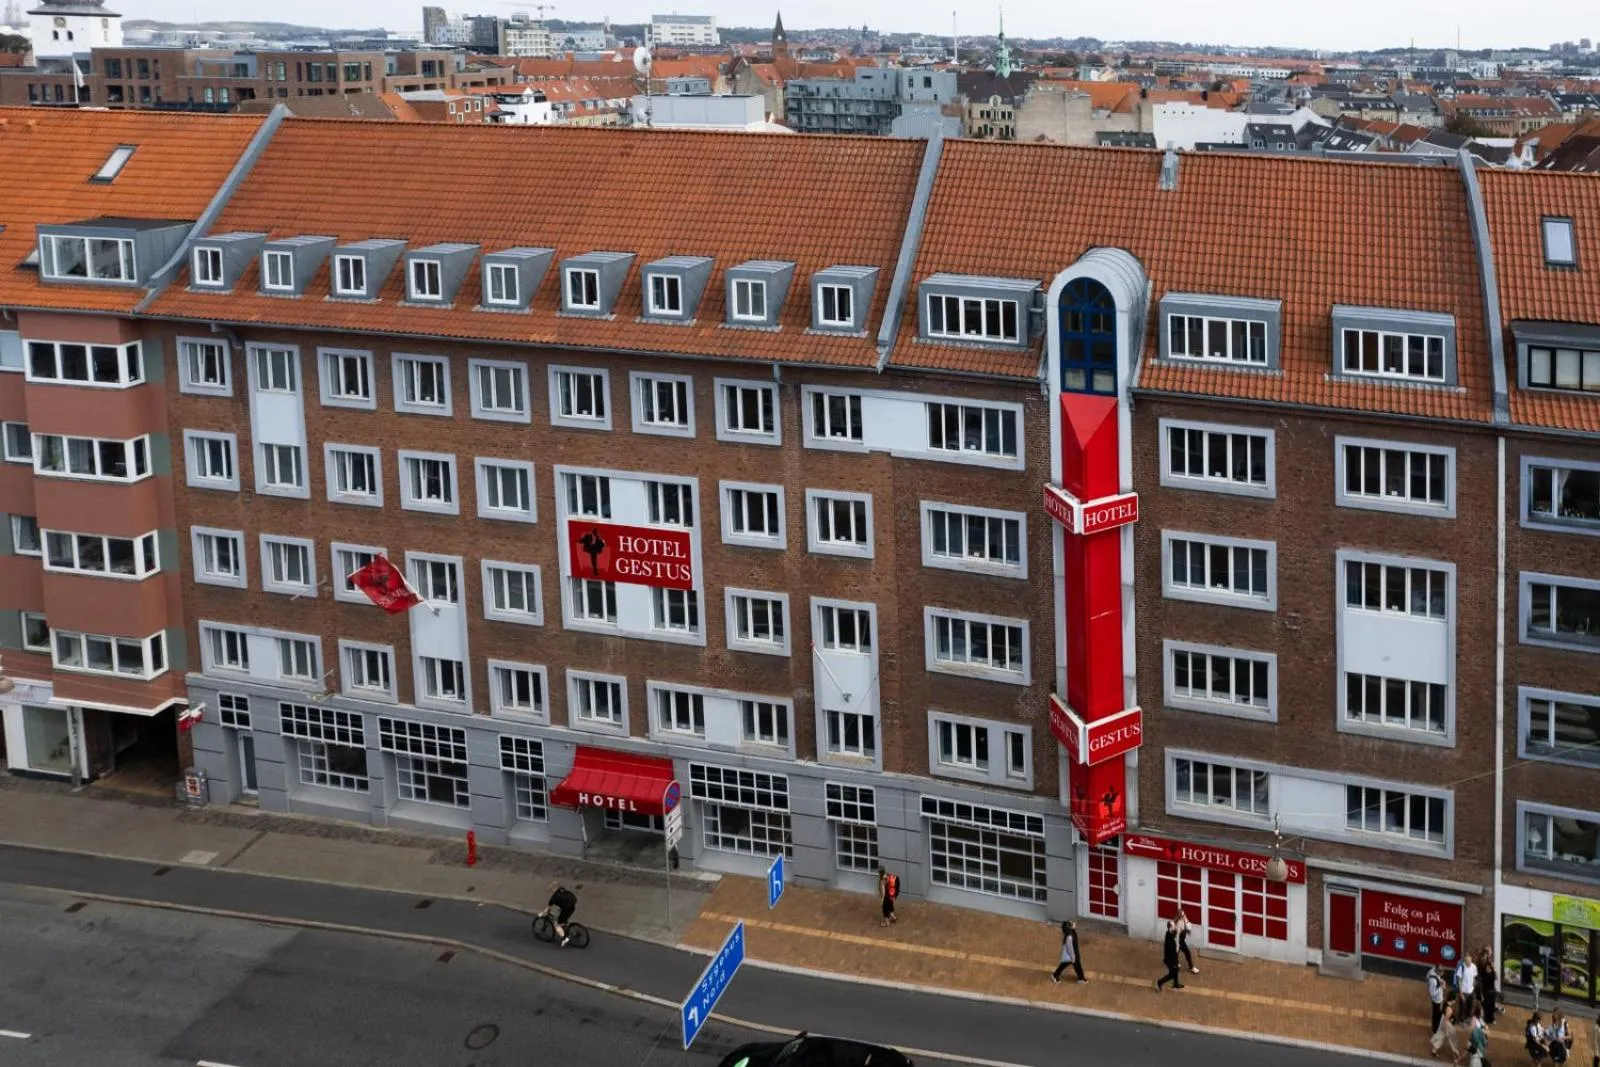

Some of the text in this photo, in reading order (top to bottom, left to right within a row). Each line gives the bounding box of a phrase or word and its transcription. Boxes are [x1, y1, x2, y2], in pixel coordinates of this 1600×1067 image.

[1085, 503, 1136, 527] HOTEL
[618, 535, 686, 558] HOTEL
[615, 558, 691, 580] GESTUS
[1089, 722, 1141, 752] GESTUS
[579, 792, 637, 811] HOTEL
[1181, 847, 1298, 878] HOTEL GESS
[1426, 910, 1440, 923] på
[1368, 916, 1456, 941] millinghotels.dk
